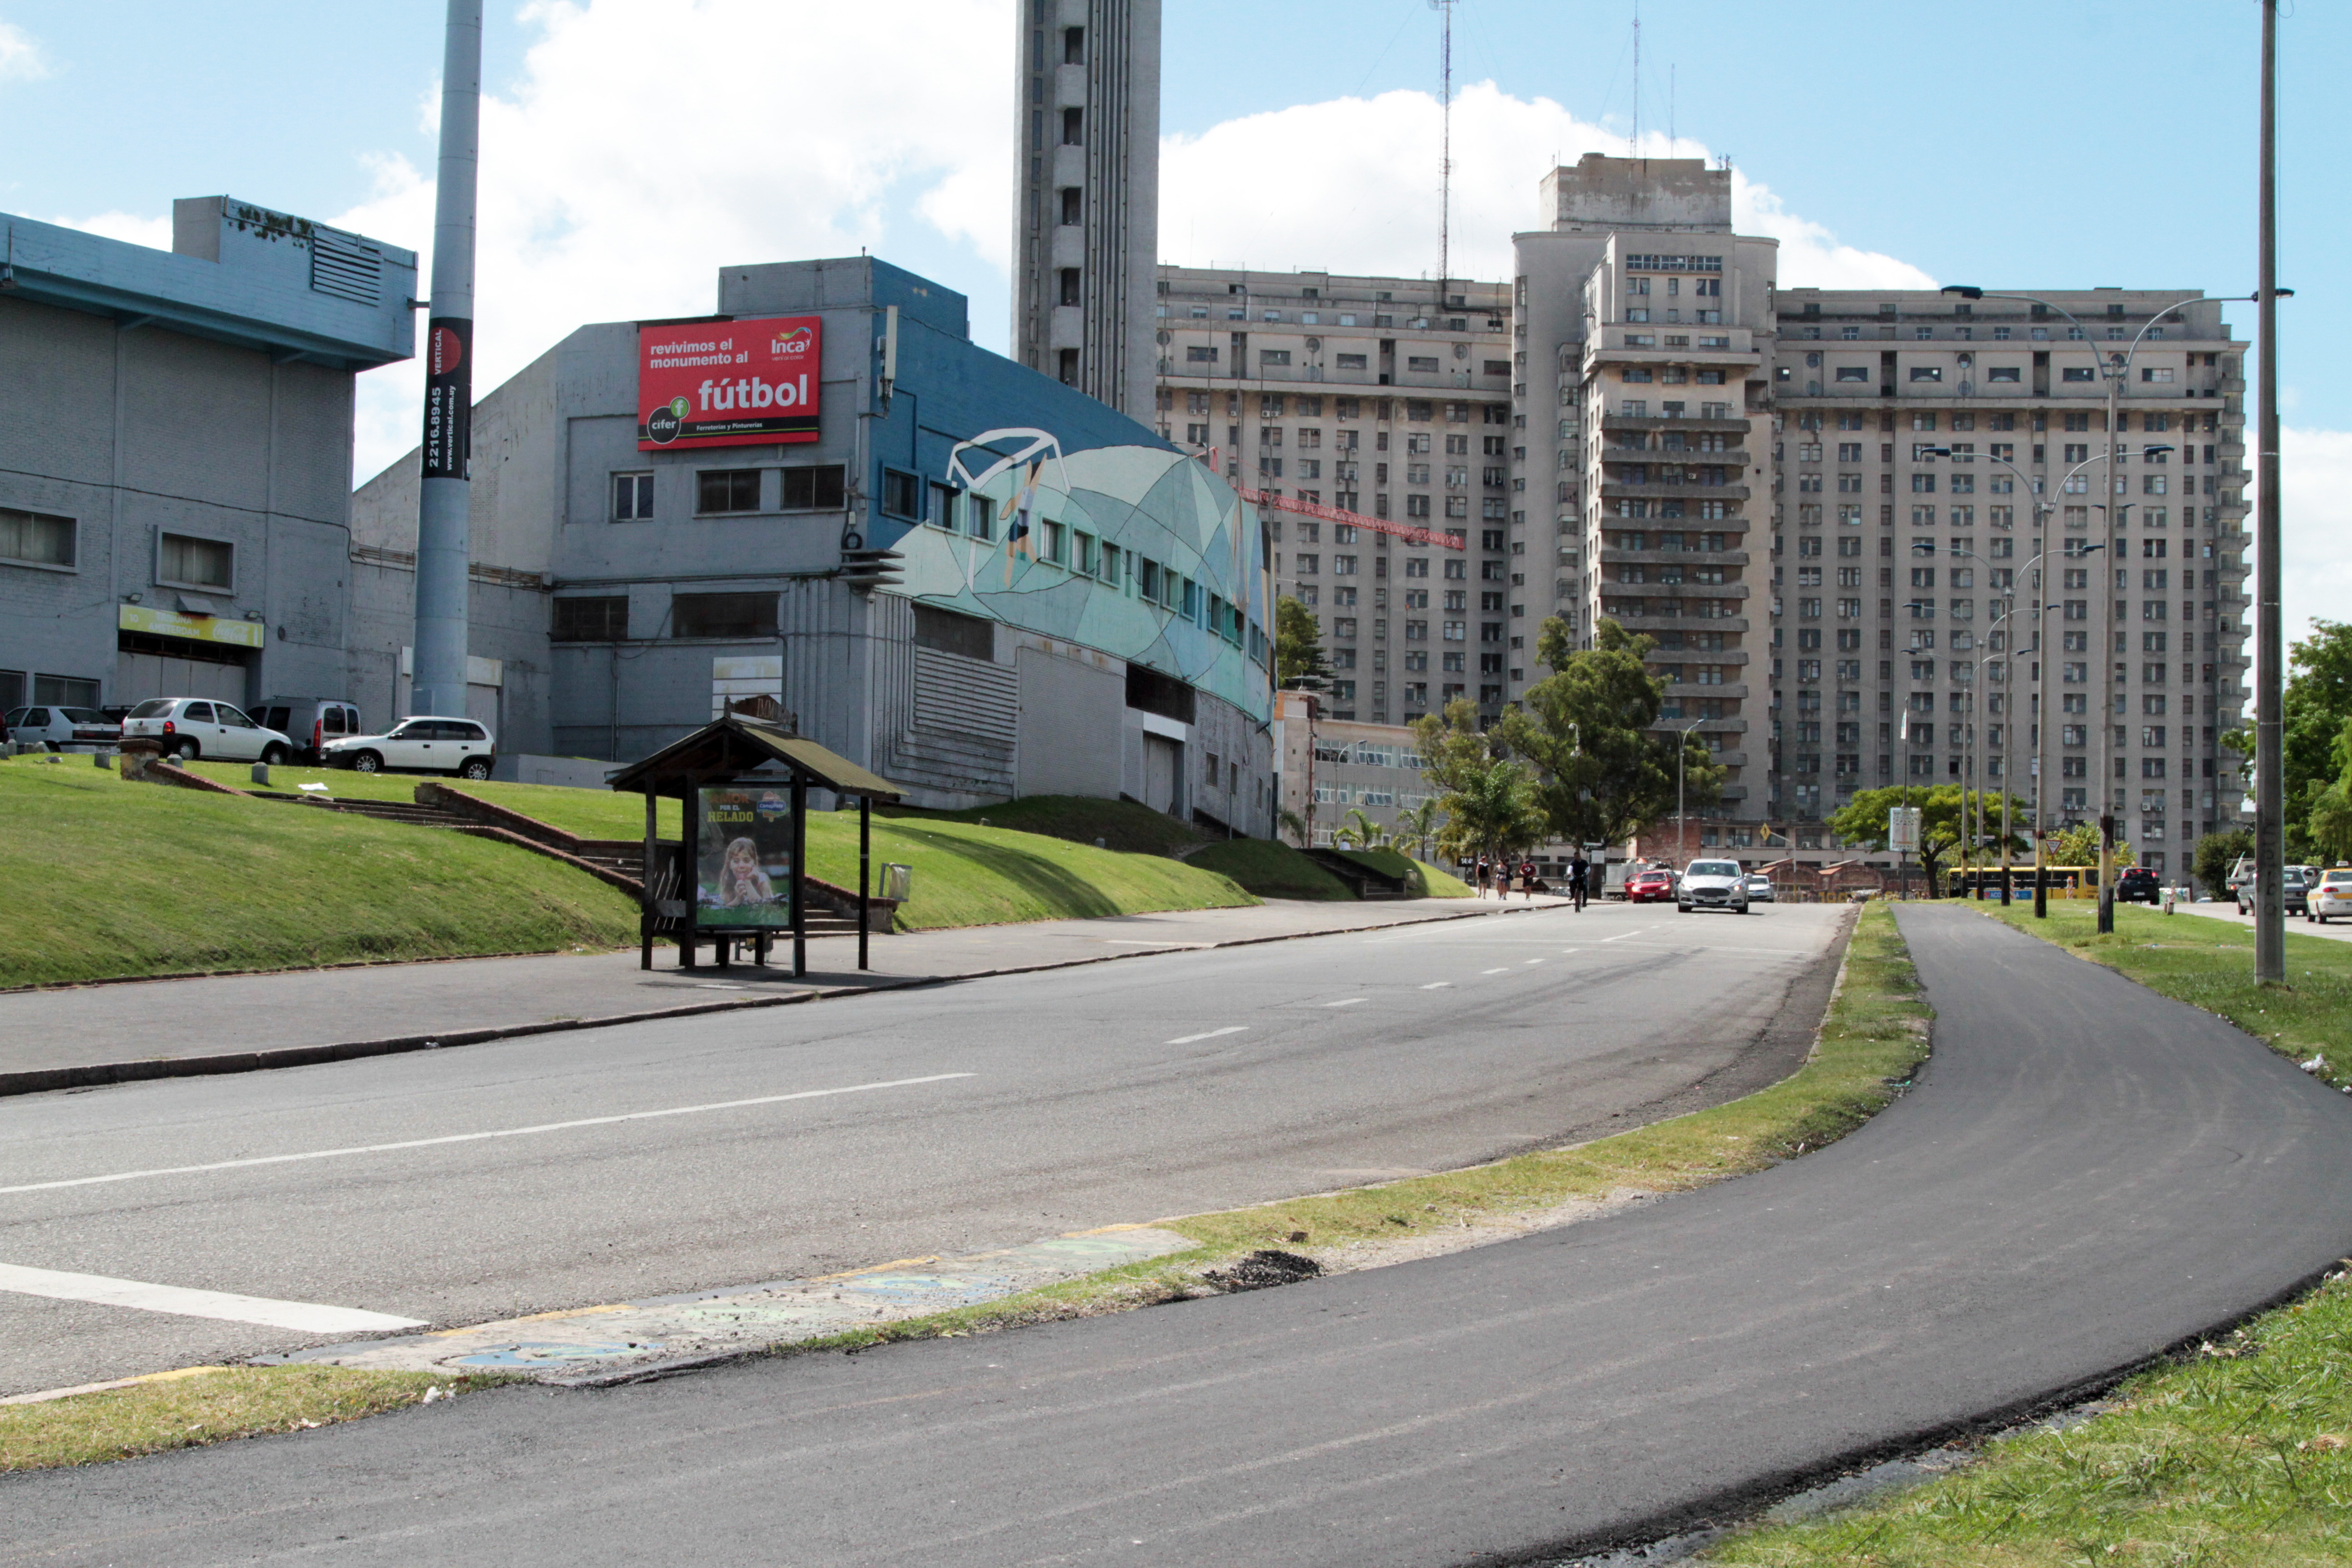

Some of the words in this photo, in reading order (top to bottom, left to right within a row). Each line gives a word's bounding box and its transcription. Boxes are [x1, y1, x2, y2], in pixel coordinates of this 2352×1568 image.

[651, 341, 715, 355] revivimos
[720, 338, 732, 350] el
[772, 339, 805, 353] Inca
[650, 353, 731, 369] monumento
[736, 351, 748, 363] al
[698, 374, 808, 411] fútbol
[429, 387, 441, 468] 2216.8945
[447, 385, 456, 470] www.vertical.com.uy
[652, 419, 676, 430] cifer
[129, 614, 138, 623] 10
[148, 622, 200, 637] AMSTERDAM
[708, 811, 753, 822] HELADO
